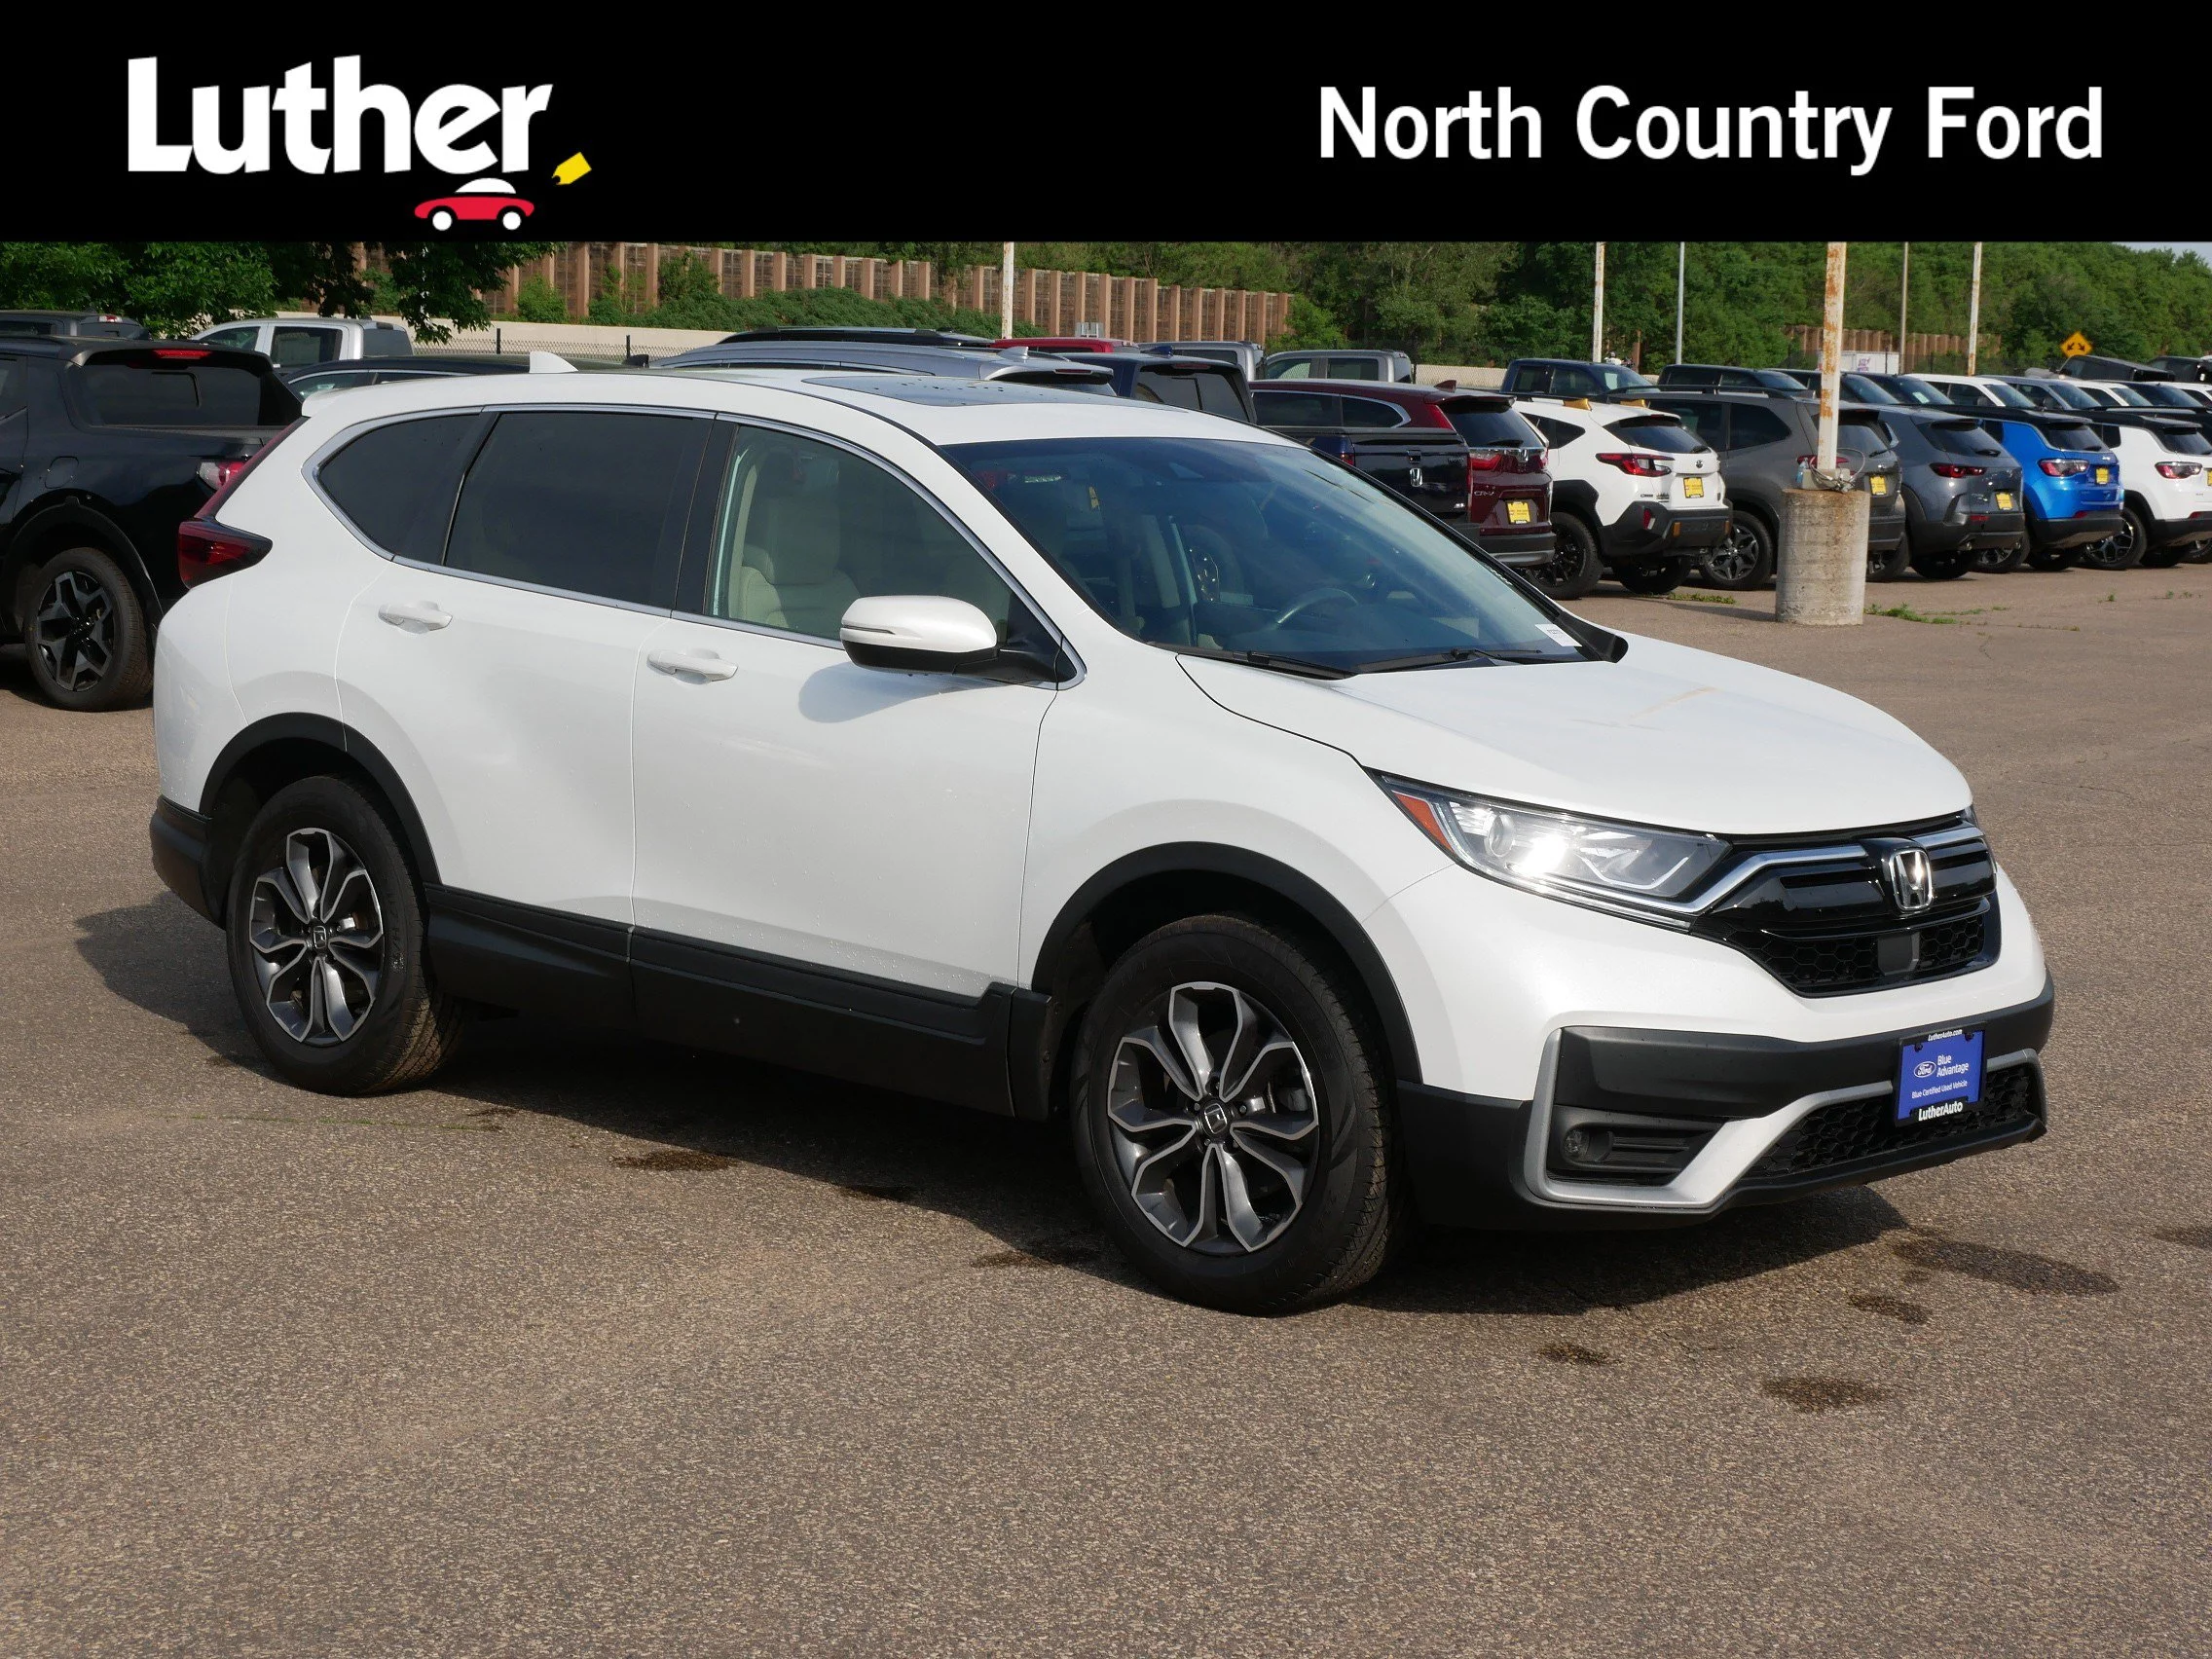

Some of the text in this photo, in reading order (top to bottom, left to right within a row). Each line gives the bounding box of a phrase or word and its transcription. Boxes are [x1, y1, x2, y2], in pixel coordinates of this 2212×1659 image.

[1928, 1029, 1963, 1042] LutherAuto.com
[1937, 1054, 1951, 1066] Blue
[1917, 1063, 1934, 1076] Ford
[1936, 1063, 1969, 1078] Advantage
[1922, 1086, 1940, 1096] Certified
[1941, 1083, 1952, 1091] Used
[1953, 1080, 1968, 1089] Vehicle
[1918, 1101, 1963, 1122] LutherAuto
